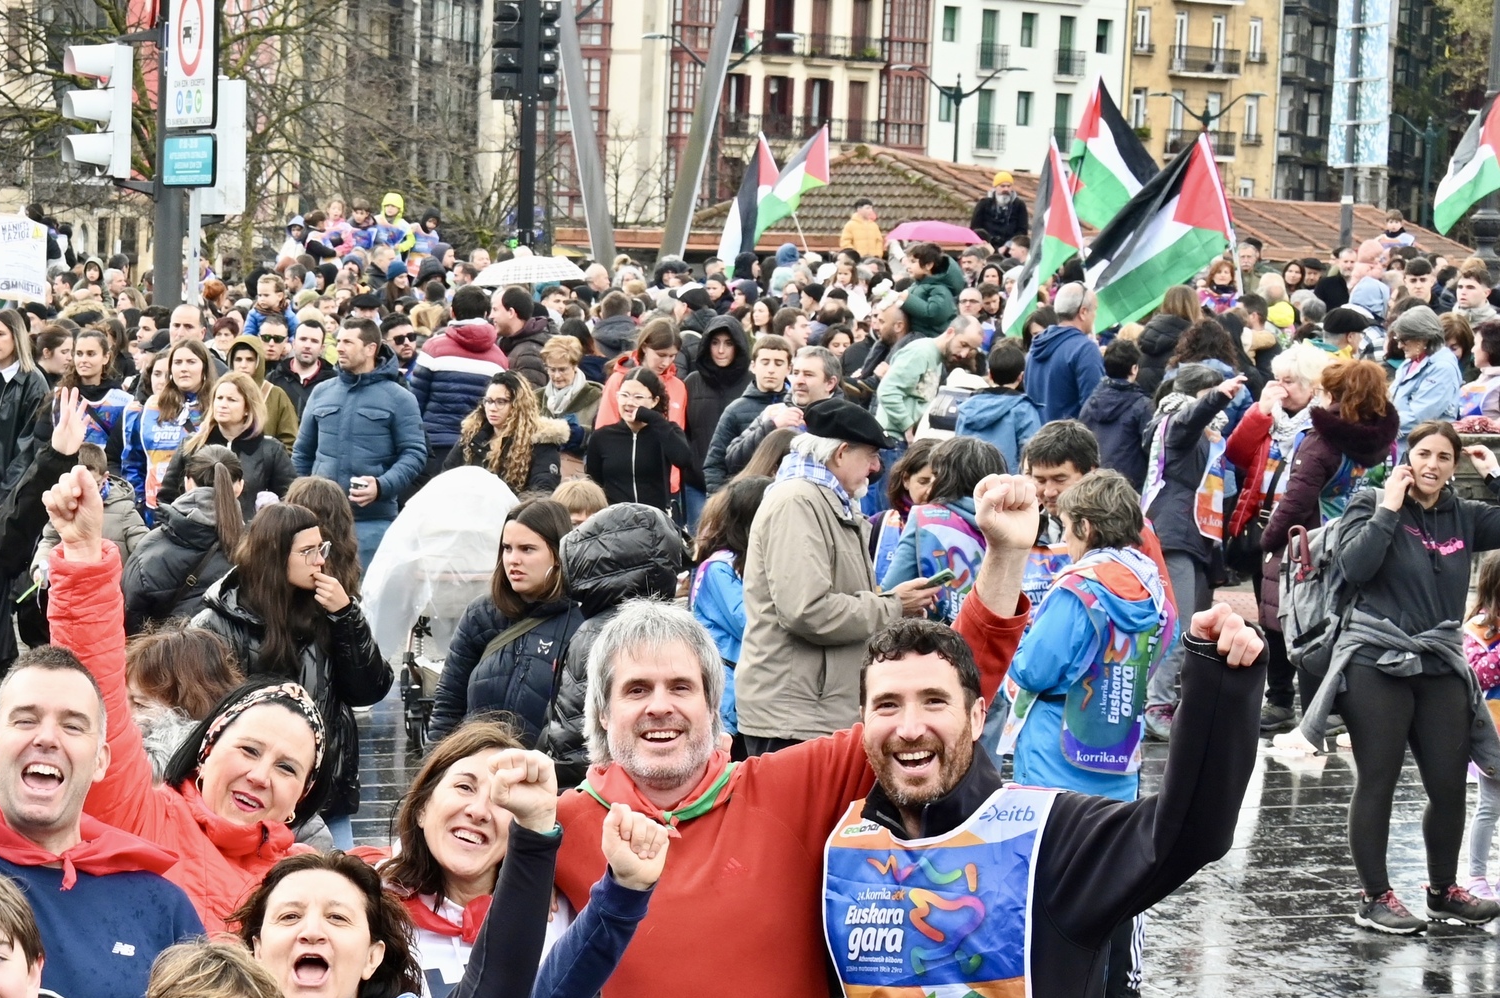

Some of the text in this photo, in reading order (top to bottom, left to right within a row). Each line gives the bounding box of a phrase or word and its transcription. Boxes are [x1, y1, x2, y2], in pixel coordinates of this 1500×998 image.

[154, 431, 180, 443] gara
[1107, 665, 1122, 724] Euskara
[997, 805, 1036, 822] eitb
[844, 902, 904, 925] Euskara
[847, 926, 904, 961] gara
